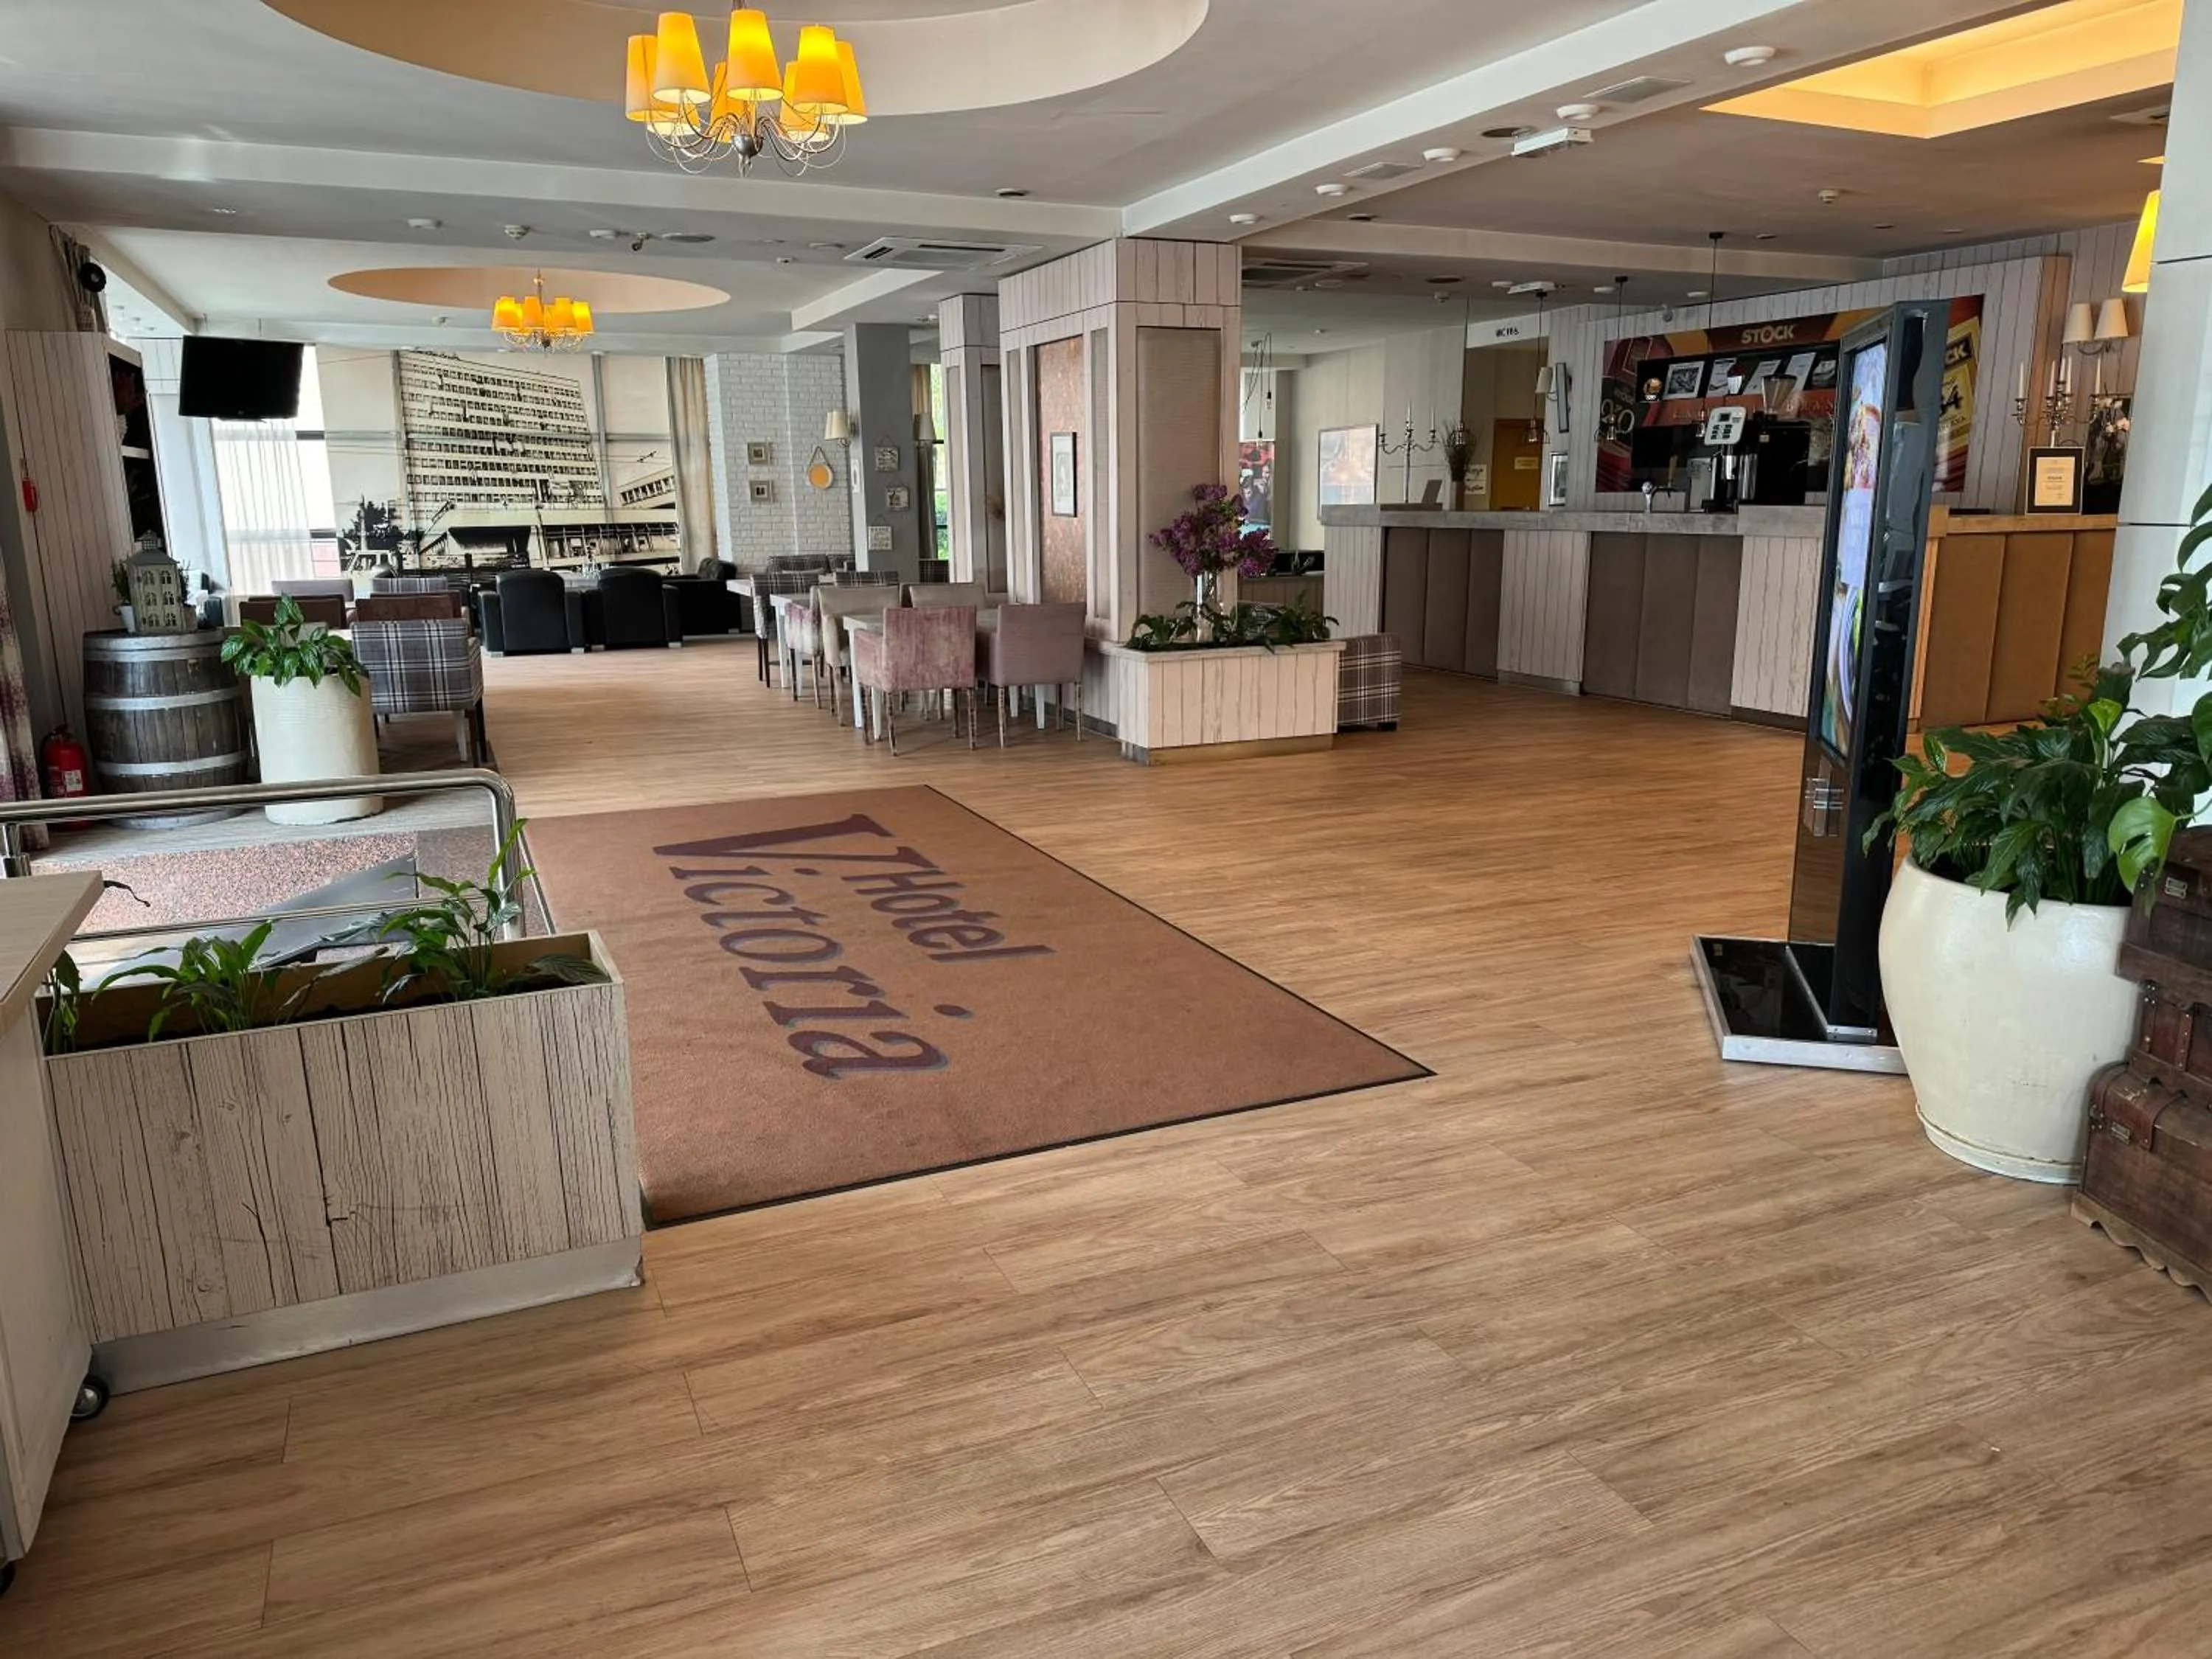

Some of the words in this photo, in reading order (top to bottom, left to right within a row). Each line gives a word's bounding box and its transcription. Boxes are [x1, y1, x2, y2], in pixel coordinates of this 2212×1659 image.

[1741, 324, 1795, 344] STOCK
[653, 813, 973, 1079] Victoria
[841, 869, 1058, 964] Hotel
